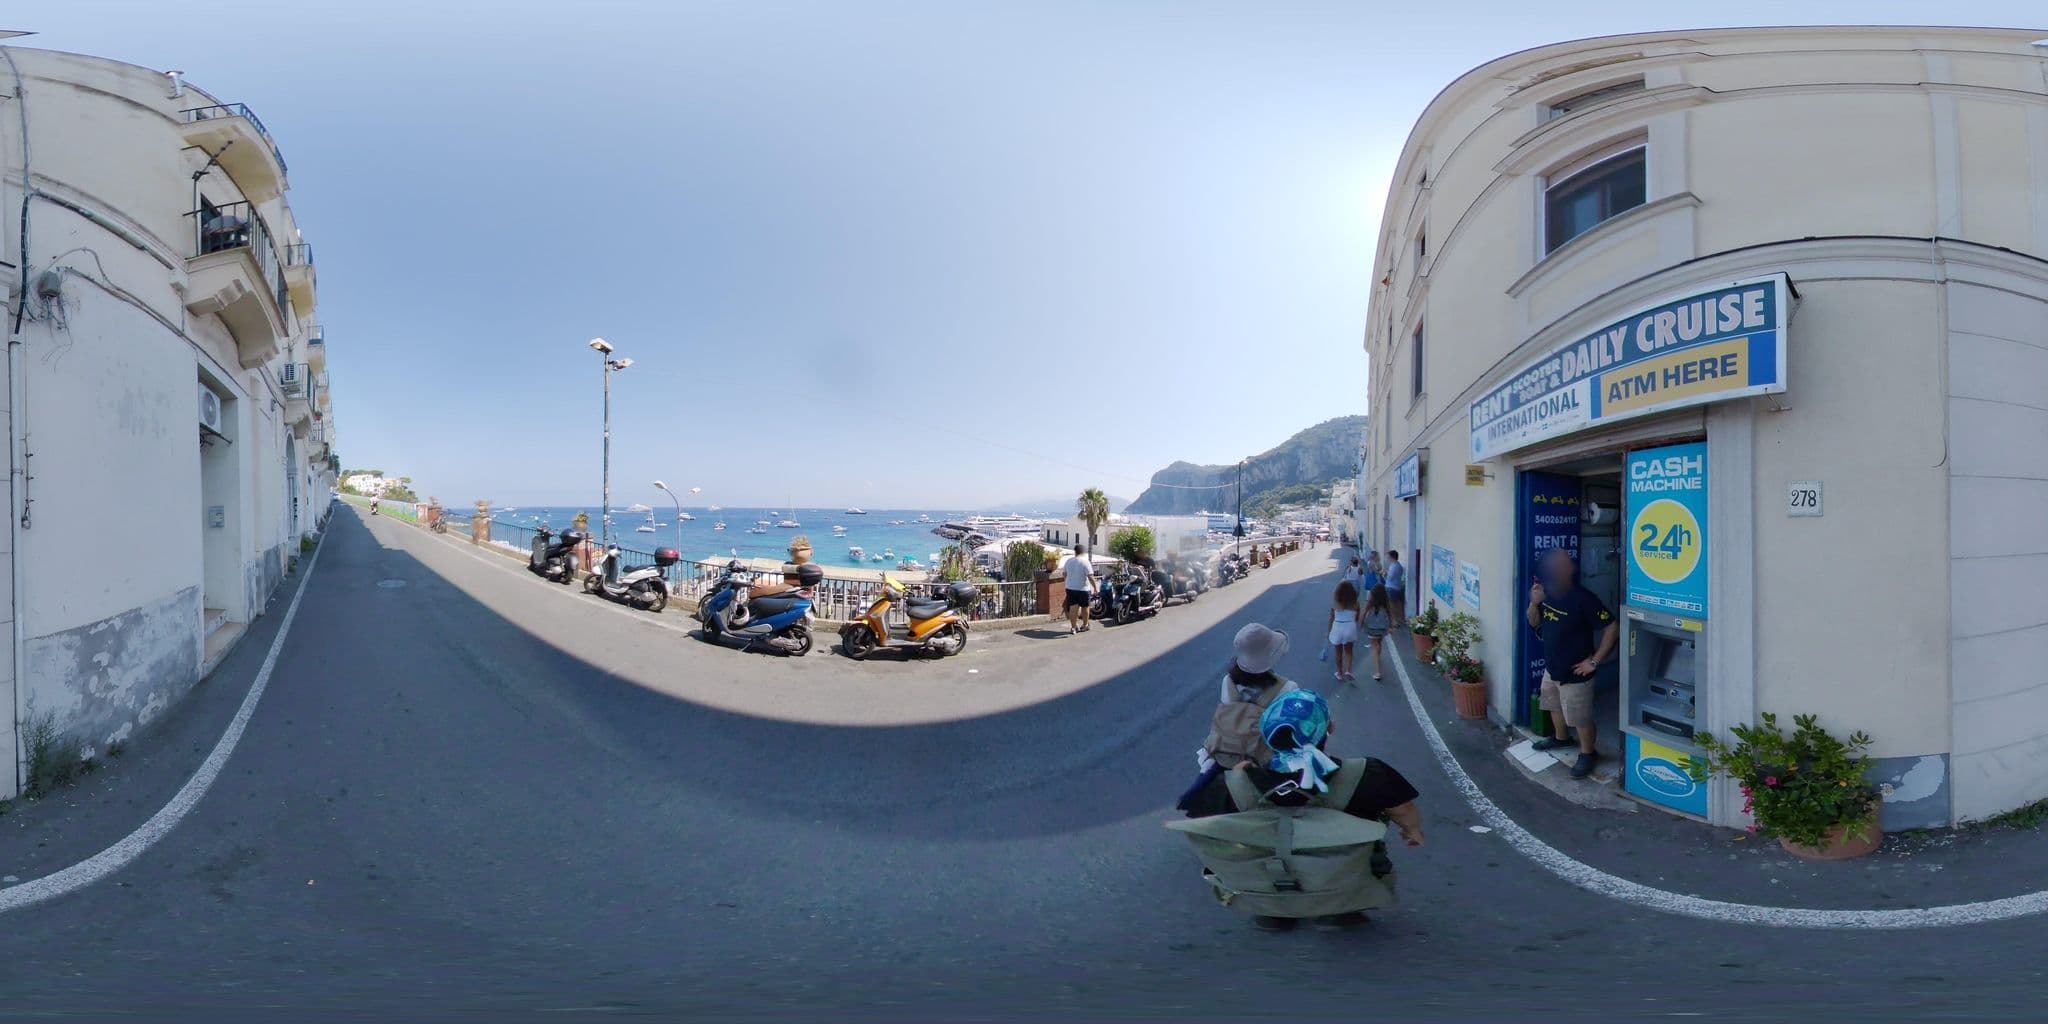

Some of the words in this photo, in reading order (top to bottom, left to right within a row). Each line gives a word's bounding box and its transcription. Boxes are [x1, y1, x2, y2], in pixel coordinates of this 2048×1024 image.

[1472, 384, 1513, 430] RENT
[1512, 358, 1561, 394] SCOOTER
[1562, 325, 1627, 383] DAILY
[1636, 289, 1765, 352] CRUISE
[1550, 373, 1561, 389] &
[1608, 370, 1657, 403] ATM
[1663, 352, 1738, 389] HERE
[1488, 388, 1580, 441] INTERNATIONAL
[1631, 454, 1702, 480] CASH
[1631, 477, 1702, 493] MACHINE
[1791, 489, 1817, 507] 278
[1534, 535, 1566, 549] RENT
[1570, 535, 1578, 547] A
[1640, 551, 1672, 560] service
